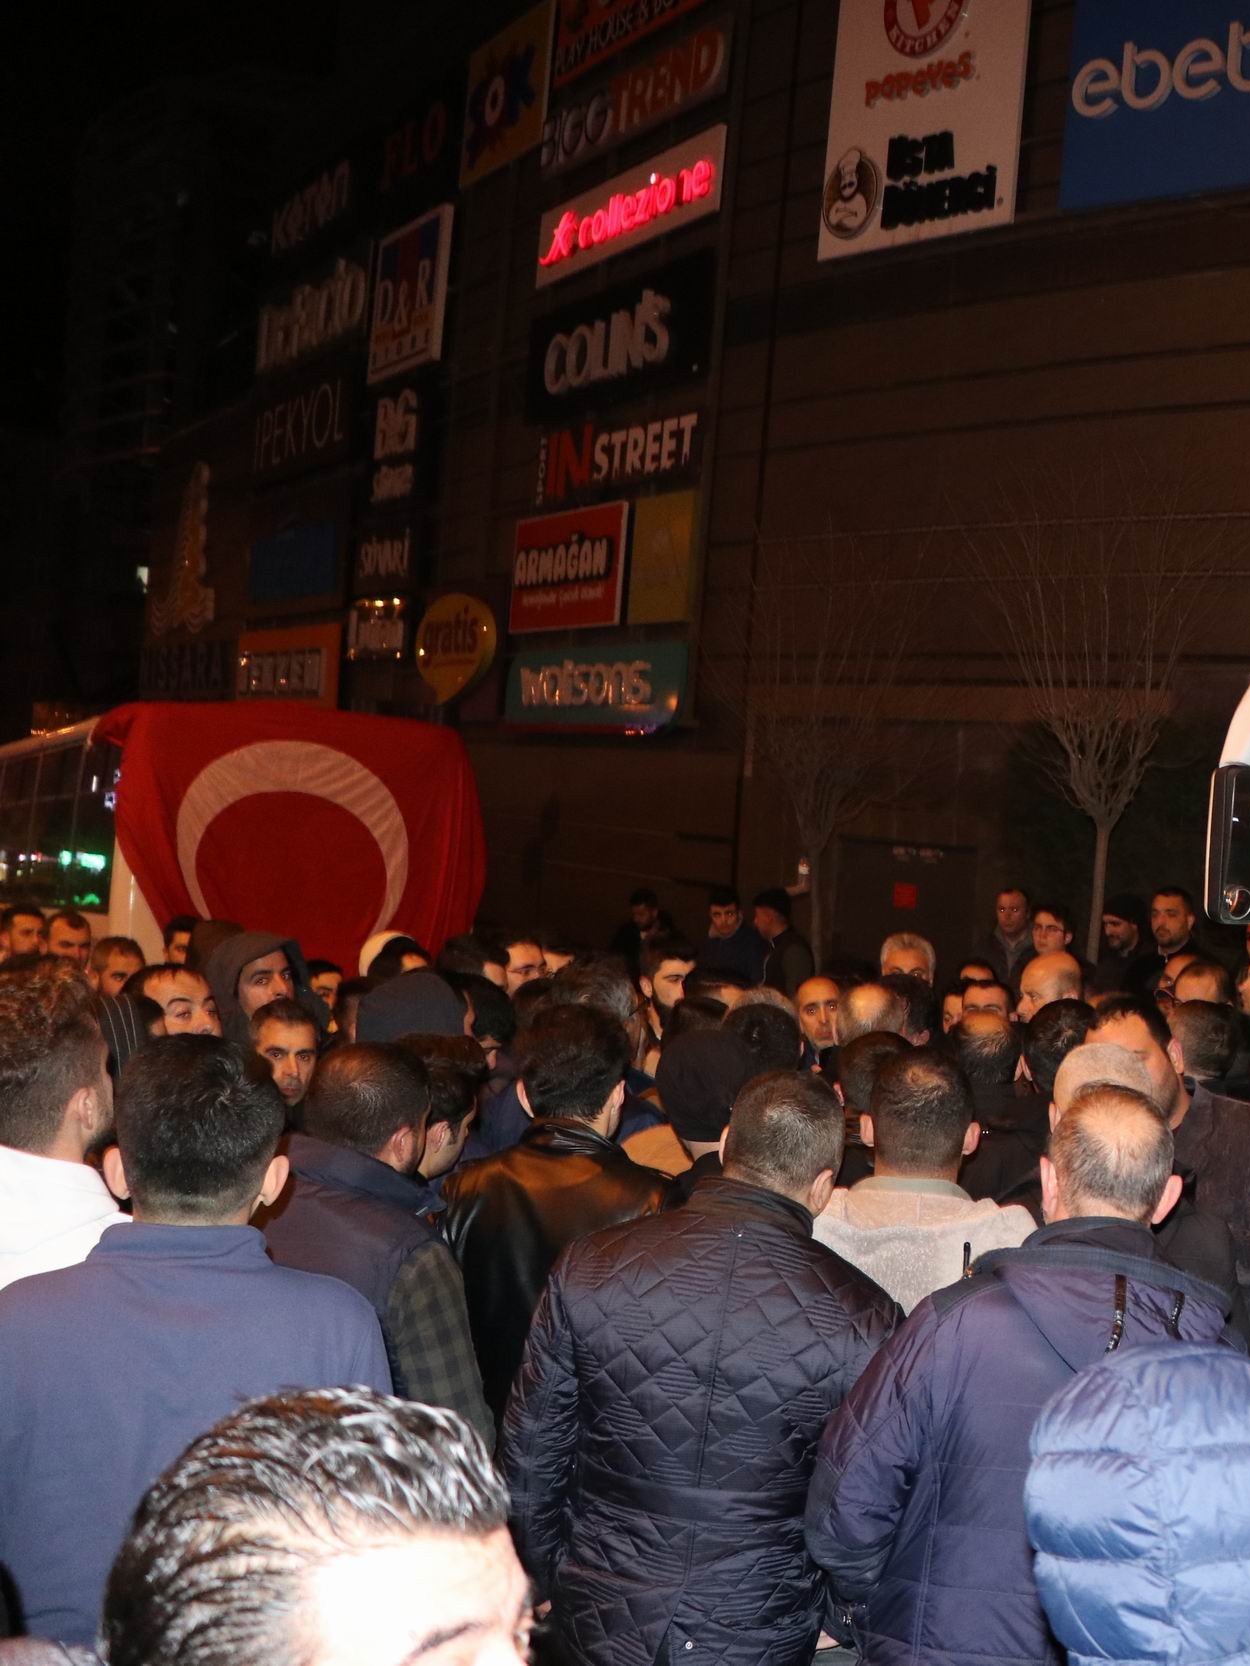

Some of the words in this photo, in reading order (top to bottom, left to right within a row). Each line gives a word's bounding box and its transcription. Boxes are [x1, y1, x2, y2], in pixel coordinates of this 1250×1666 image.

[577, 159, 712, 250] collezione
[376, 259, 432, 331] D&R
[592, 412, 698, 481] STREET
[514, 533, 609, 588] ARMAĞAN
